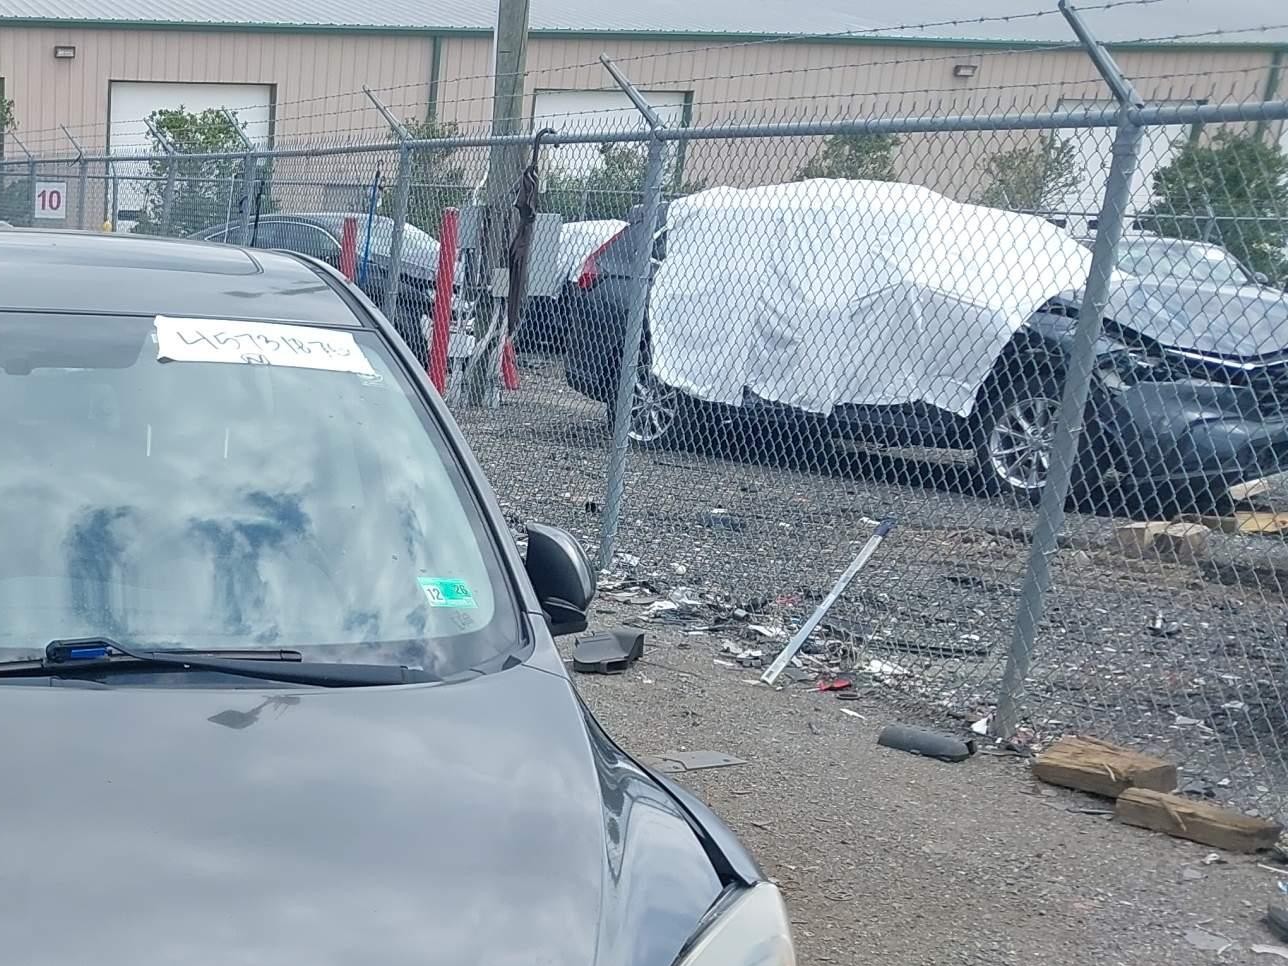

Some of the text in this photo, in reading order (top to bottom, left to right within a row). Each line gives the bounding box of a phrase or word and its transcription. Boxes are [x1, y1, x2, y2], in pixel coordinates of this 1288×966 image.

[37, 190, 62, 211] 10
[176, 329, 352, 358] 45731876
[426, 588, 444, 601] 12
